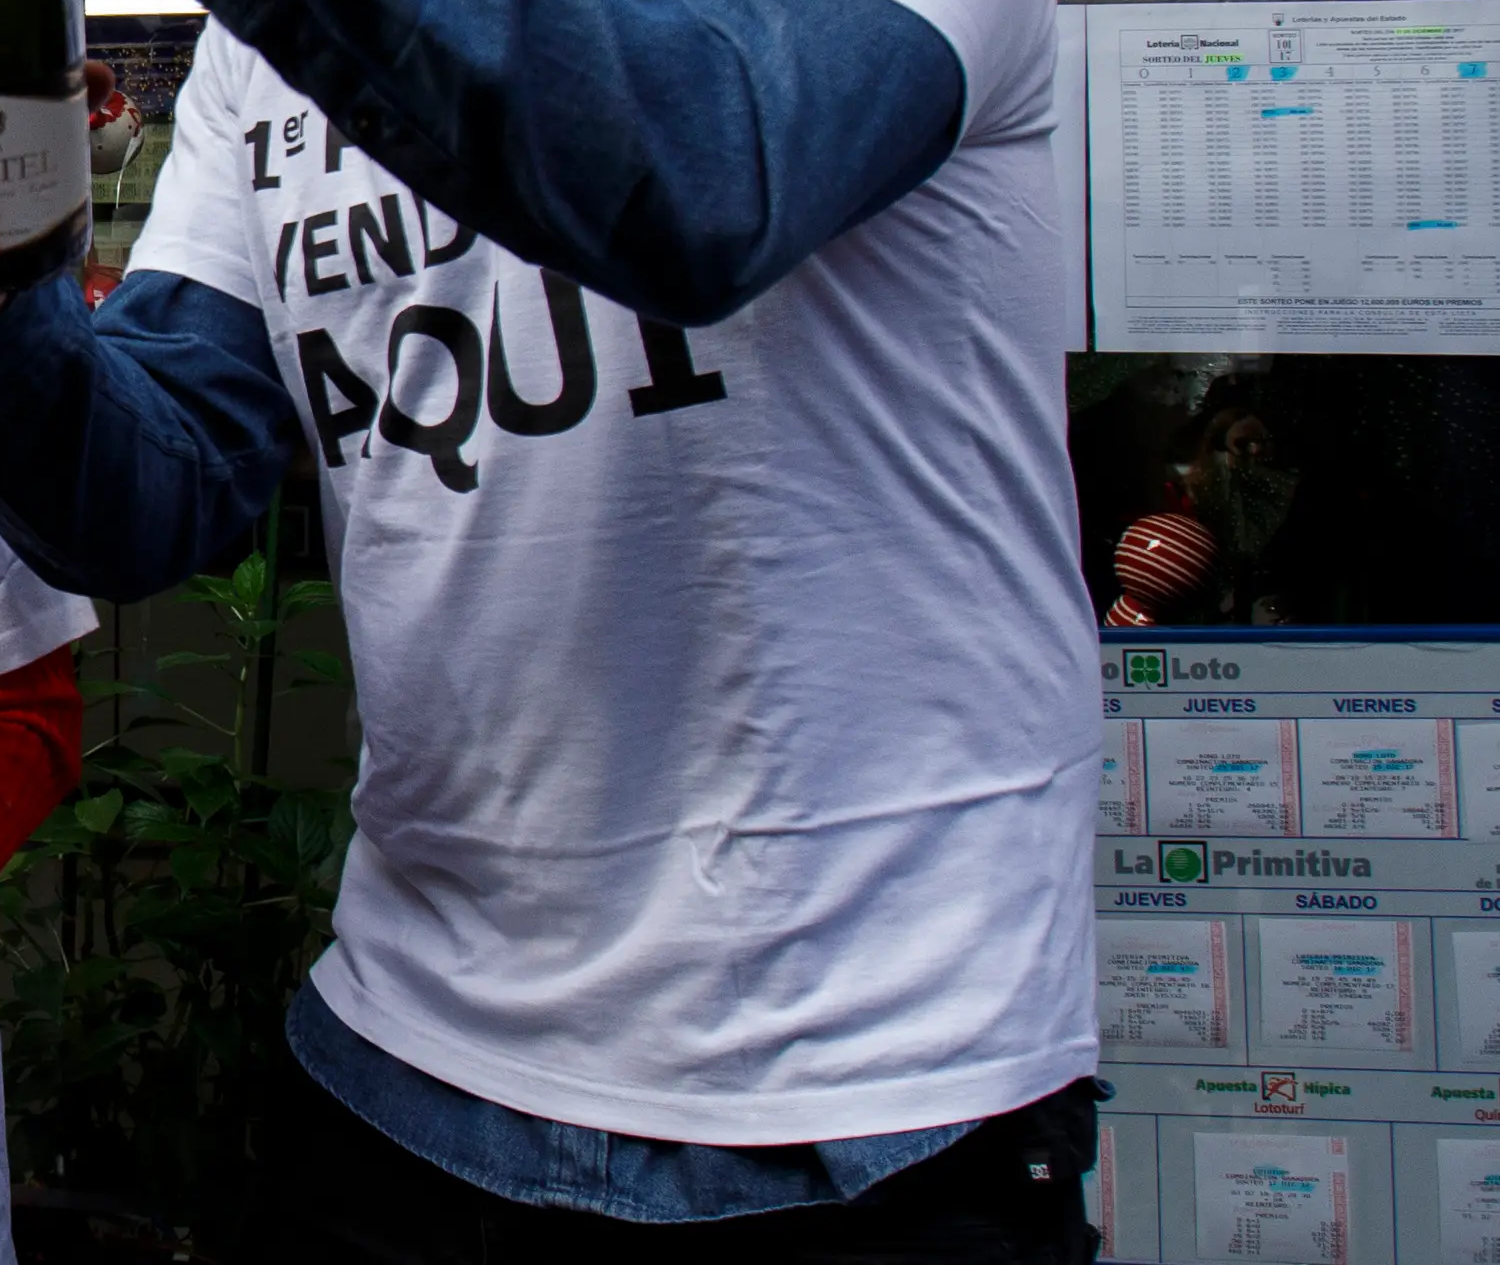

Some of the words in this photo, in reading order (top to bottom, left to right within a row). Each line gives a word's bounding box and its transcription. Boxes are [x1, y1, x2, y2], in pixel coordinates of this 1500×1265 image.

[1200, 38, 1239, 48] Nacional
[1142, 55, 1182, 64] SORTEO
[1183, 55, 1203, 64] DEL
[1204, 54, 1242, 64] JUEVES
[1171, 657, 1240, 681] Loto
[1183, 698, 1256, 713] JUEVES
[1333, 698, 1417, 713] VIERNES
[1114, 850, 1153, 875] La
[1212, 849, 1372, 878] Primitiva
[1114, 892, 1187, 908] JUEVES
[1295, 889, 1377, 910] SÁBADO
[1195, 1078, 1258, 1093] Apuesta
[1430, 1086, 1496, 1102] Apuesta
[1254, 1102, 1306, 1115] Lototurf
